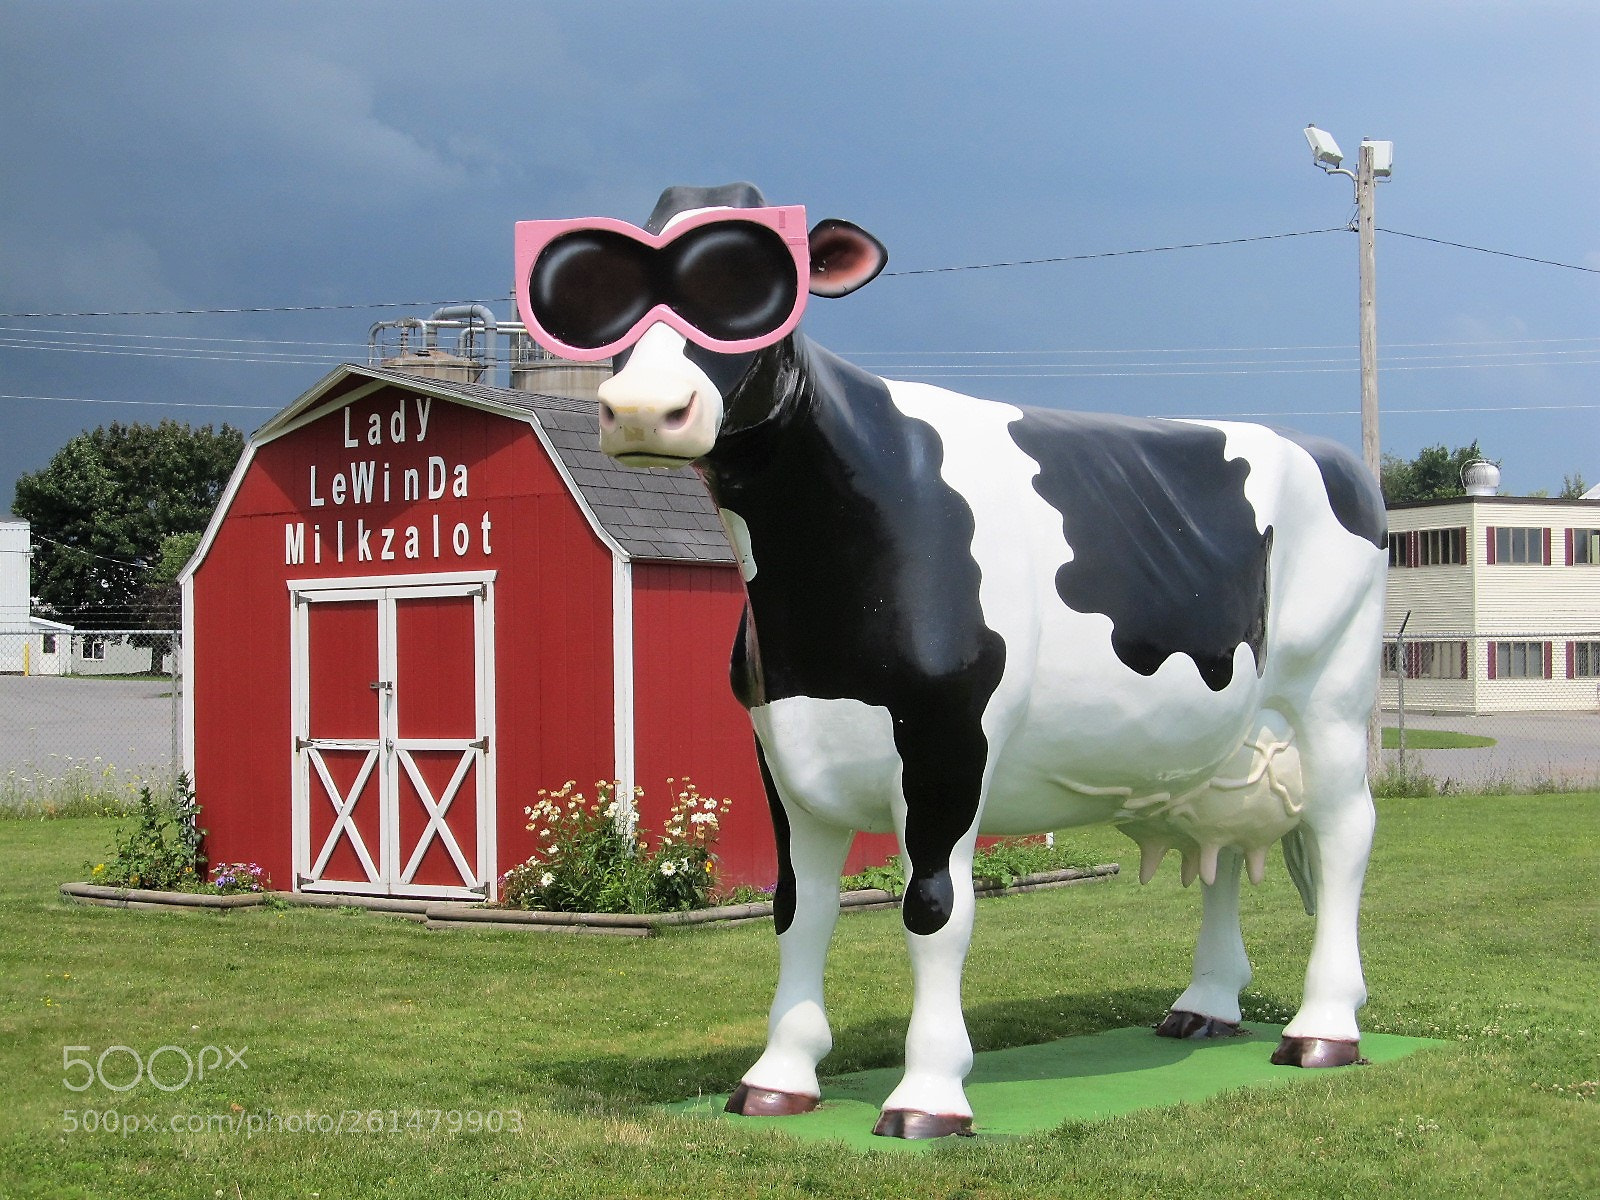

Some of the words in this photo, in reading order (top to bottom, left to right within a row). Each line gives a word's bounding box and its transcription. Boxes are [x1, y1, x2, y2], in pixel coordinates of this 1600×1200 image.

[344, 397, 431, 448] Lady
[310, 455, 468, 507] LeWinDa
[285, 510, 492, 565] Milkzalot
